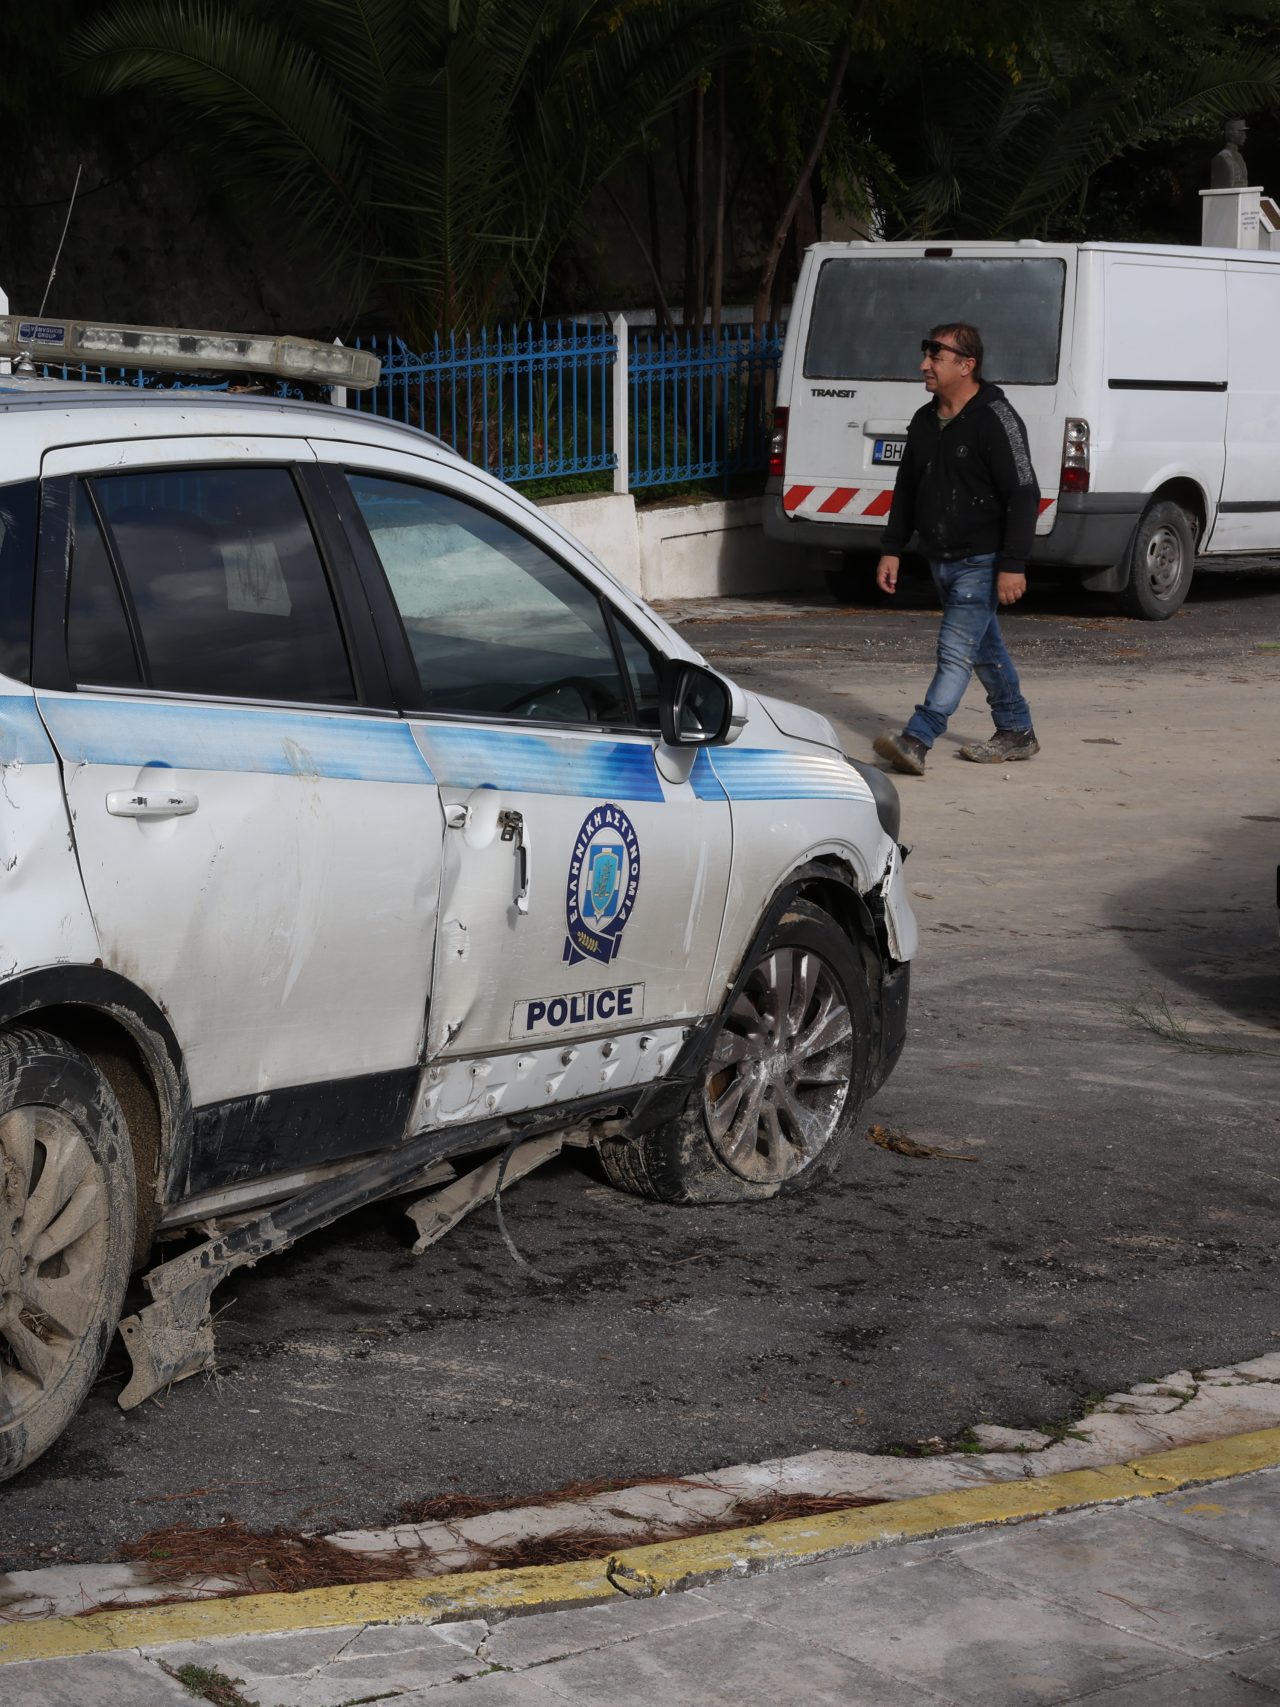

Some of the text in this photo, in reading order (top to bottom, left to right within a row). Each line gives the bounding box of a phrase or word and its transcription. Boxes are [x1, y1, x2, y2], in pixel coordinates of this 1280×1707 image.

[811, 389, 857, 398] TRANSIT
[570, 809, 639, 923] ΕΛΛΗΝΙΚΗ ΑΣΤΥΝΟΜΙΑ
[526, 988, 632, 1030] POLICE
